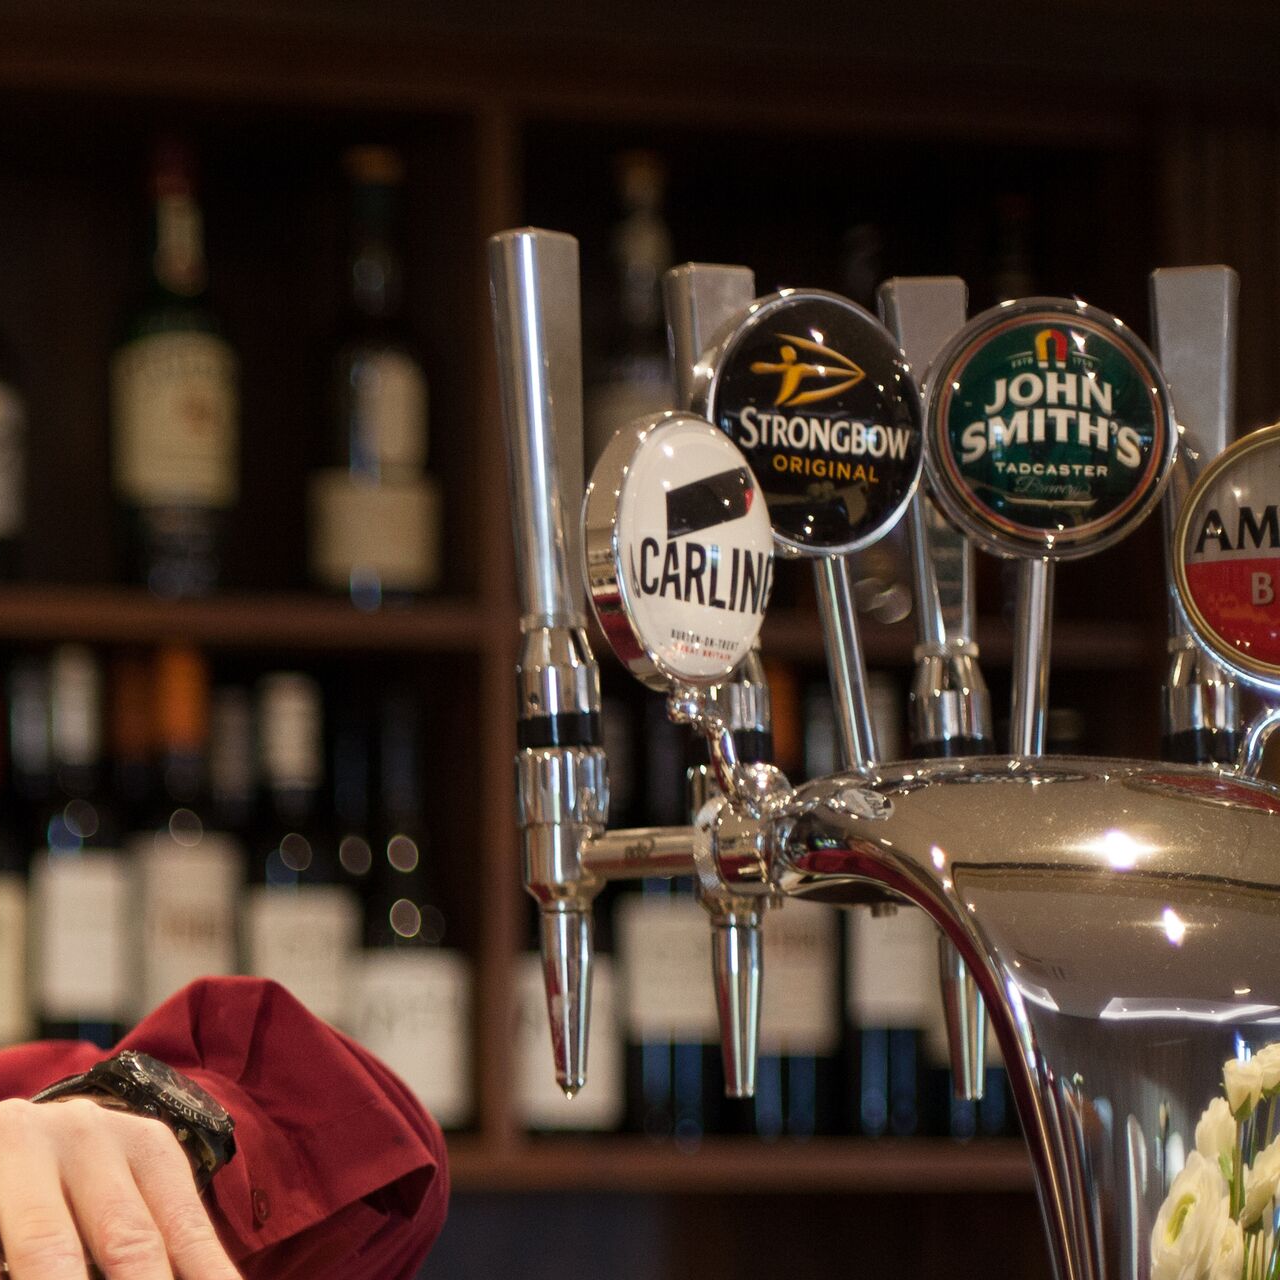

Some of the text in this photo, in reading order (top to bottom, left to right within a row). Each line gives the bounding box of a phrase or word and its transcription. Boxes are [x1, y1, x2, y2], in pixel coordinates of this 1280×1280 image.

[984, 372, 1113, 416] JOHN
[739, 406, 910, 461] STRONGBOW
[961, 408, 1141, 469] SMITH'S
[772, 454, 880, 483] ORIGINAL
[994, 461, 1109, 477] TADCASTER
